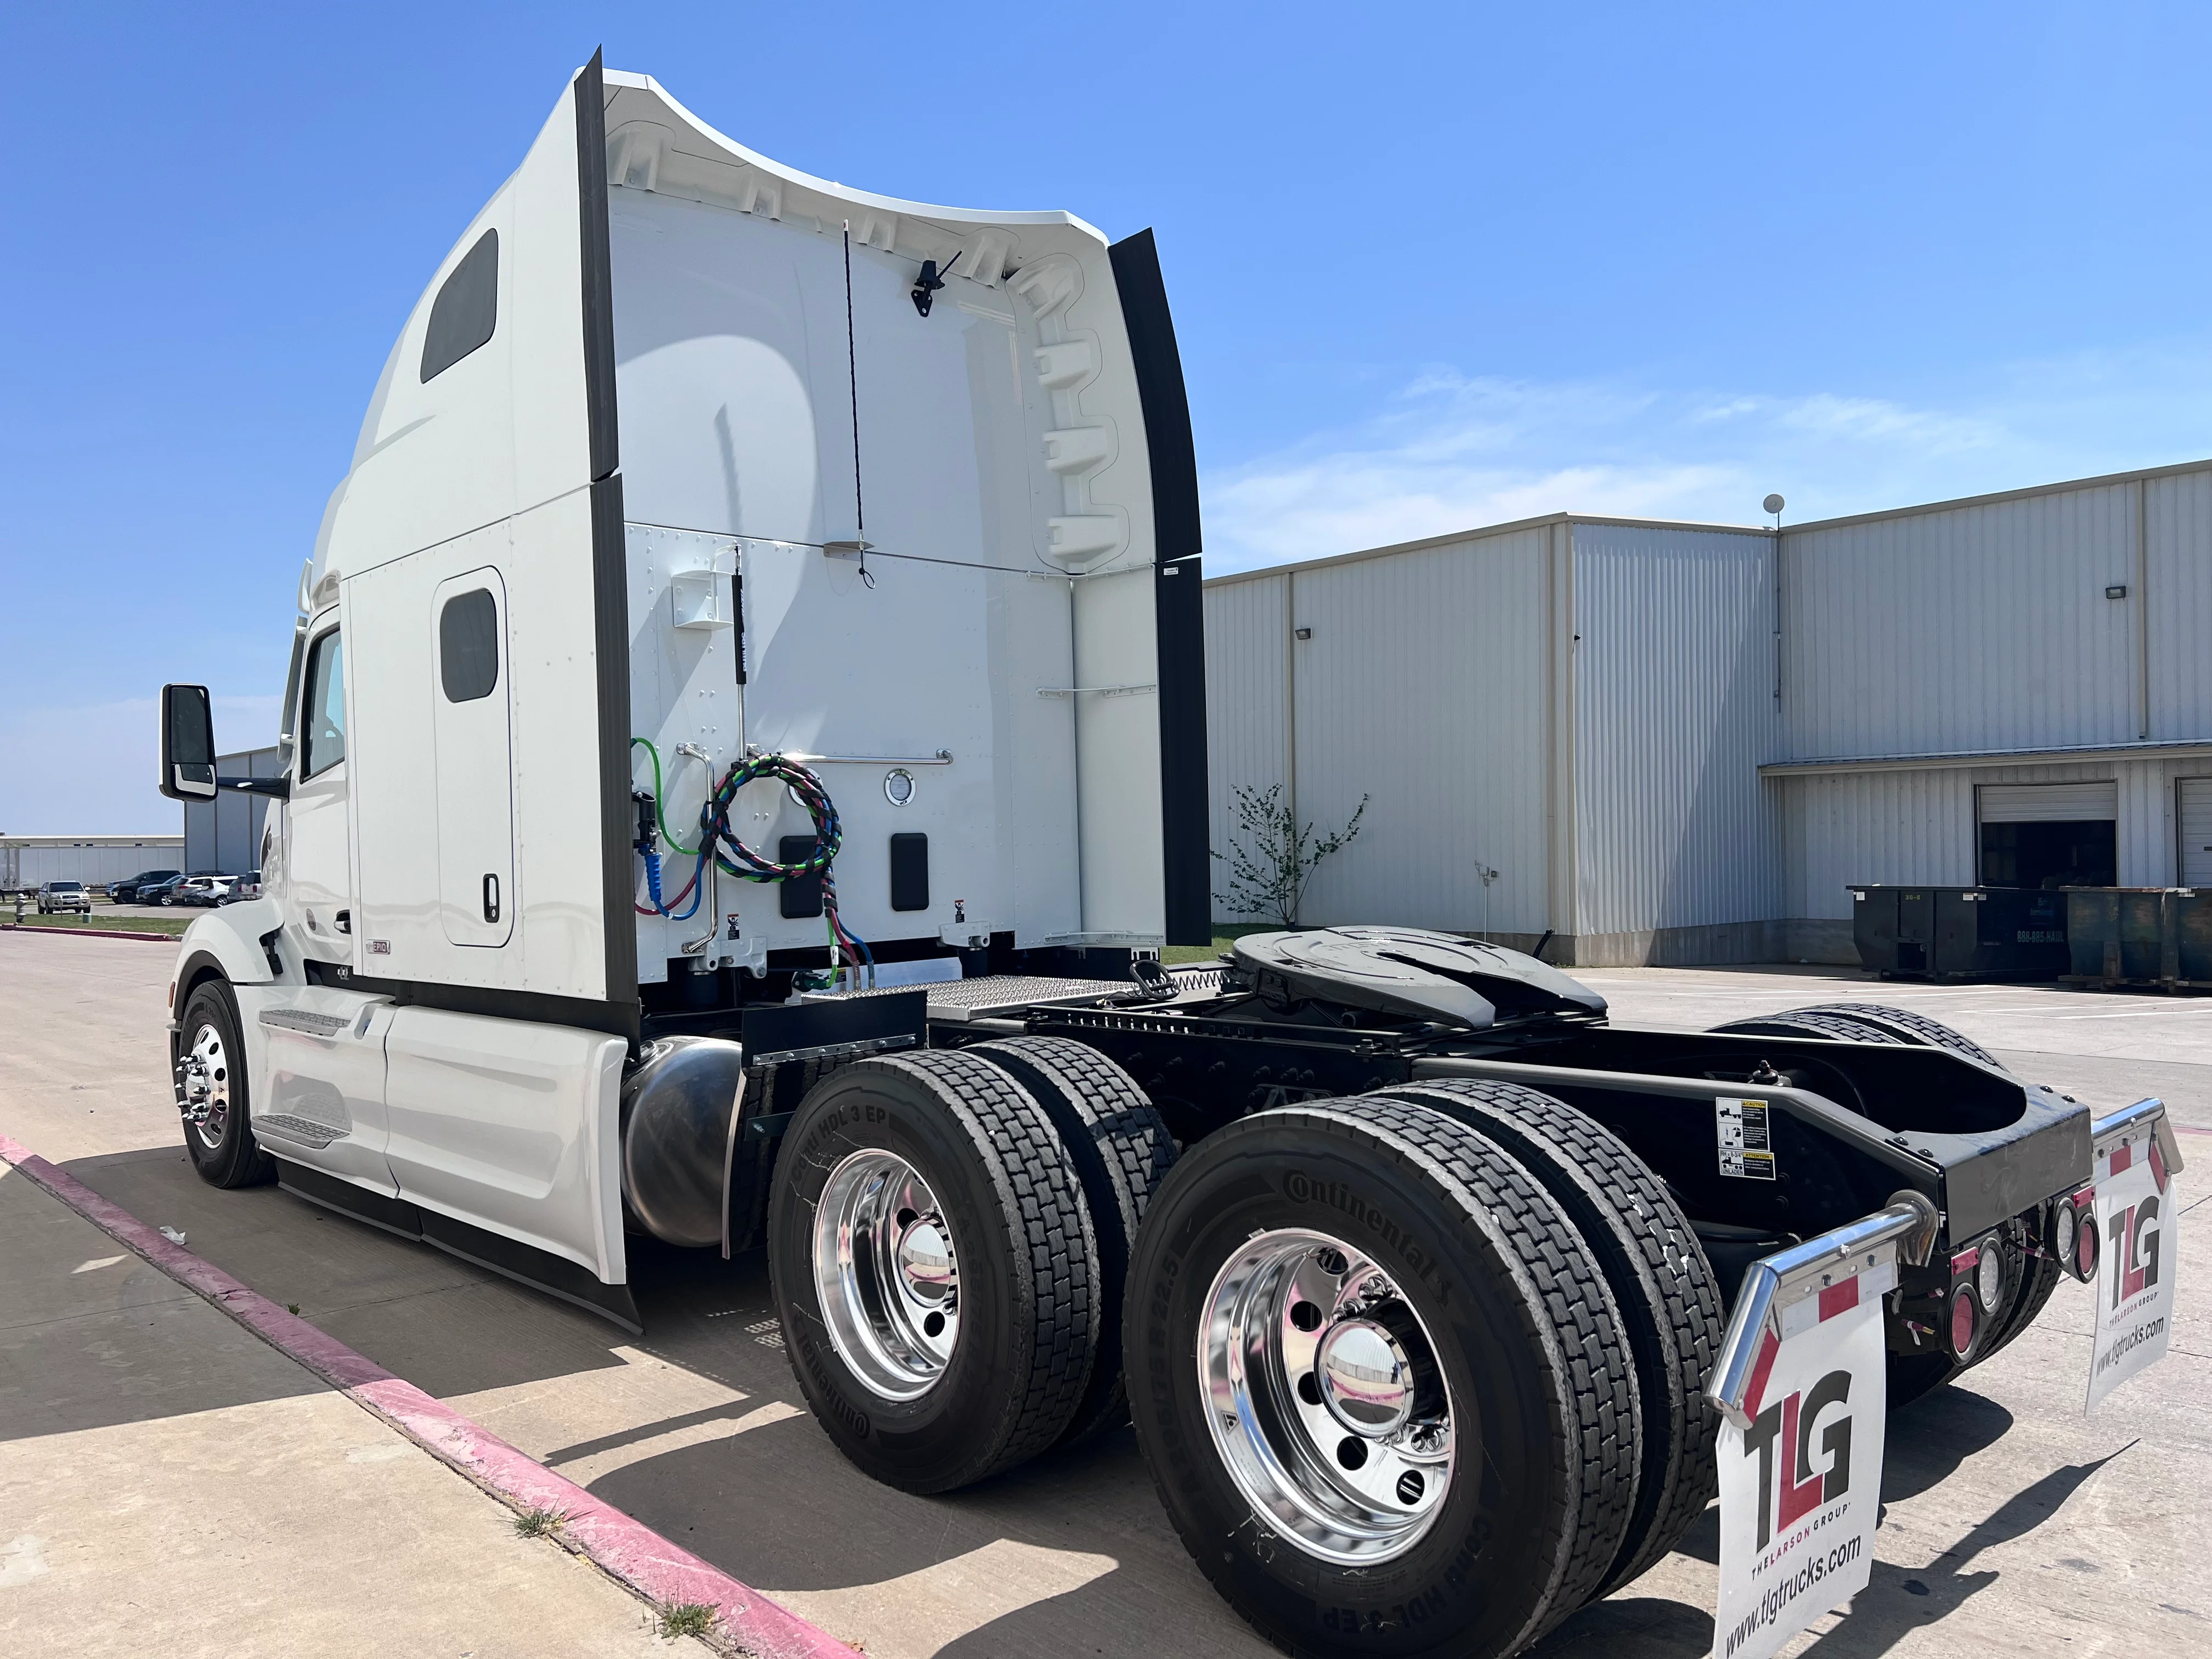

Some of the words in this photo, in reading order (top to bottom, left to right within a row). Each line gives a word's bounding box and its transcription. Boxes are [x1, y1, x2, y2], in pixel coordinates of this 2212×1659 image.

[373, 943, 386, 952] EPIQ
[818, 1109, 848, 1139] HDL
[850, 1105, 860, 1122] 3
[865, 1104, 886, 1124] EP
[1283, 1168, 1438, 1283] Continental
[2108, 1195, 2160, 1311] TLG
[1151, 1254, 1179, 1322] 22.5
[2138, 1291, 2158, 1307] GROUP
[2096, 1316, 2164, 1378] www.tlgtrucks.com
[796, 1334, 871, 1439] Continental
[1743, 1369, 1853, 1555] TLG
[1813, 1504, 1848, 1530] GROUP
[1322, 1606, 1361, 1634] EP
[1726, 1534, 1861, 1659] www.tlgtrucks.com
